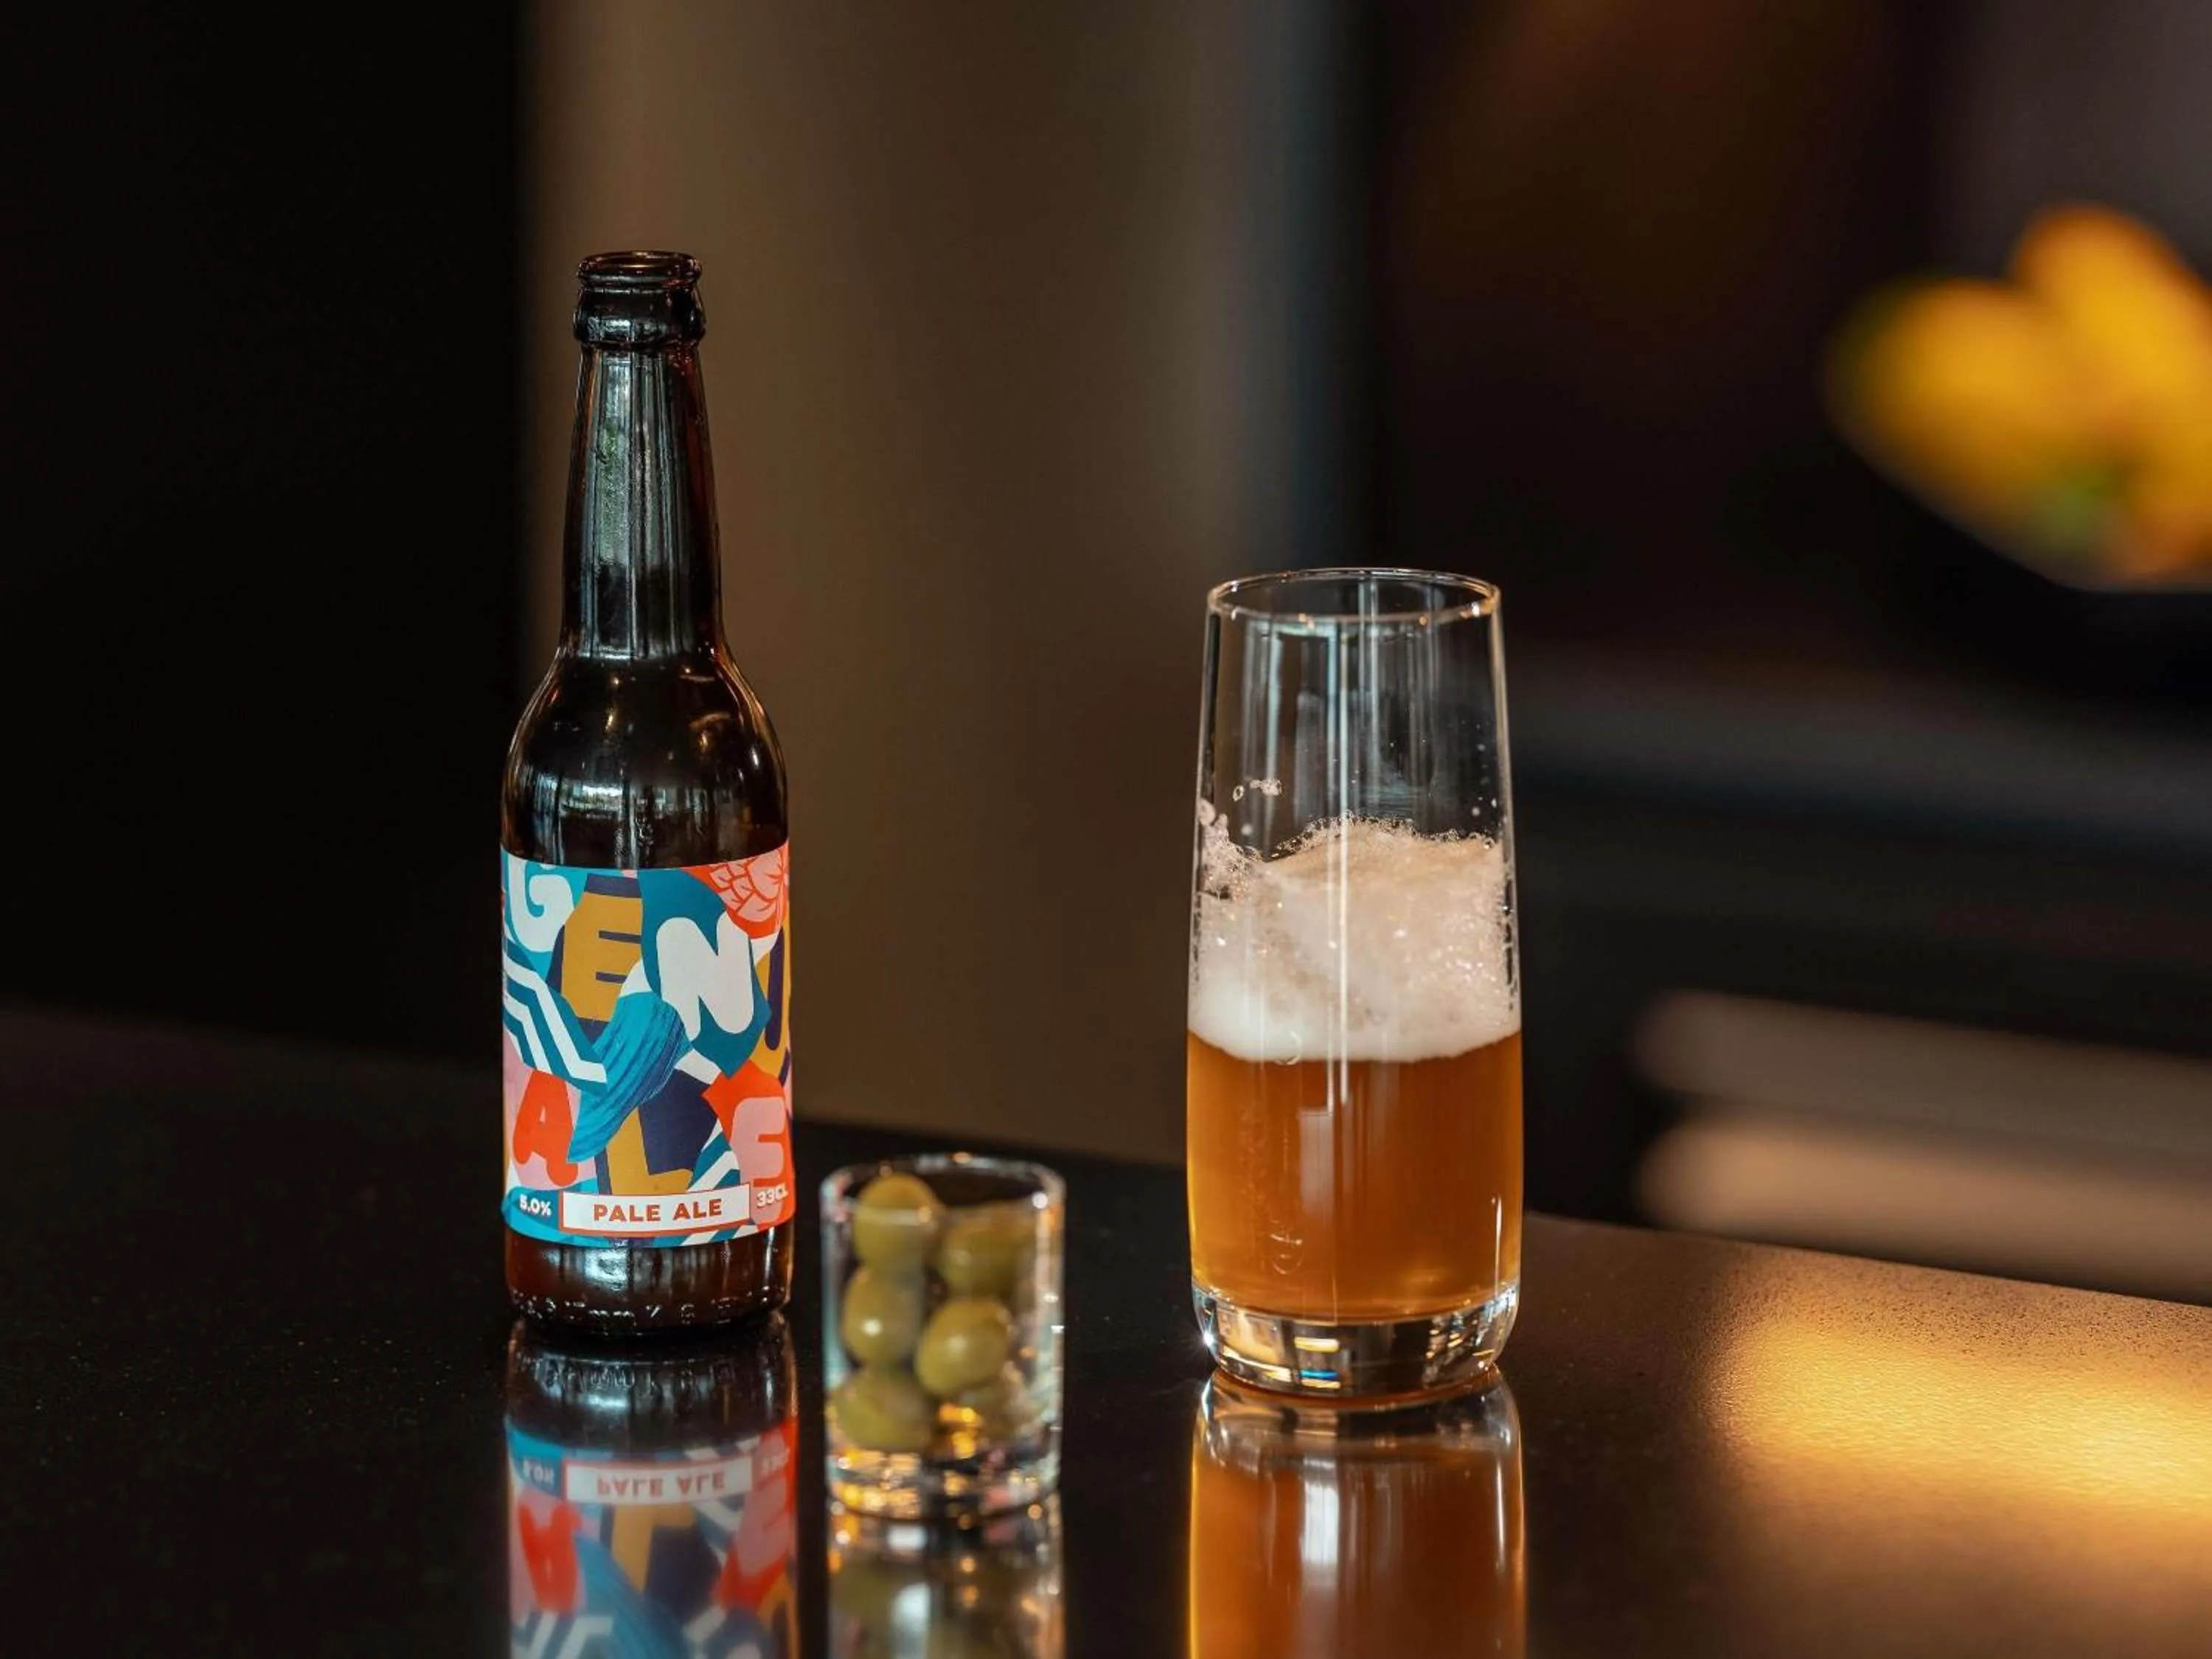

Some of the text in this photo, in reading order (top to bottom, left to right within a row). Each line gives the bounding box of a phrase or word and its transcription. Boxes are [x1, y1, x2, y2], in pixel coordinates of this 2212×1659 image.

[518, 1193, 553, 1217] 5.0%
[756, 1182, 789, 1208] 33CL
[593, 1197, 723, 1223] PALE ALE
